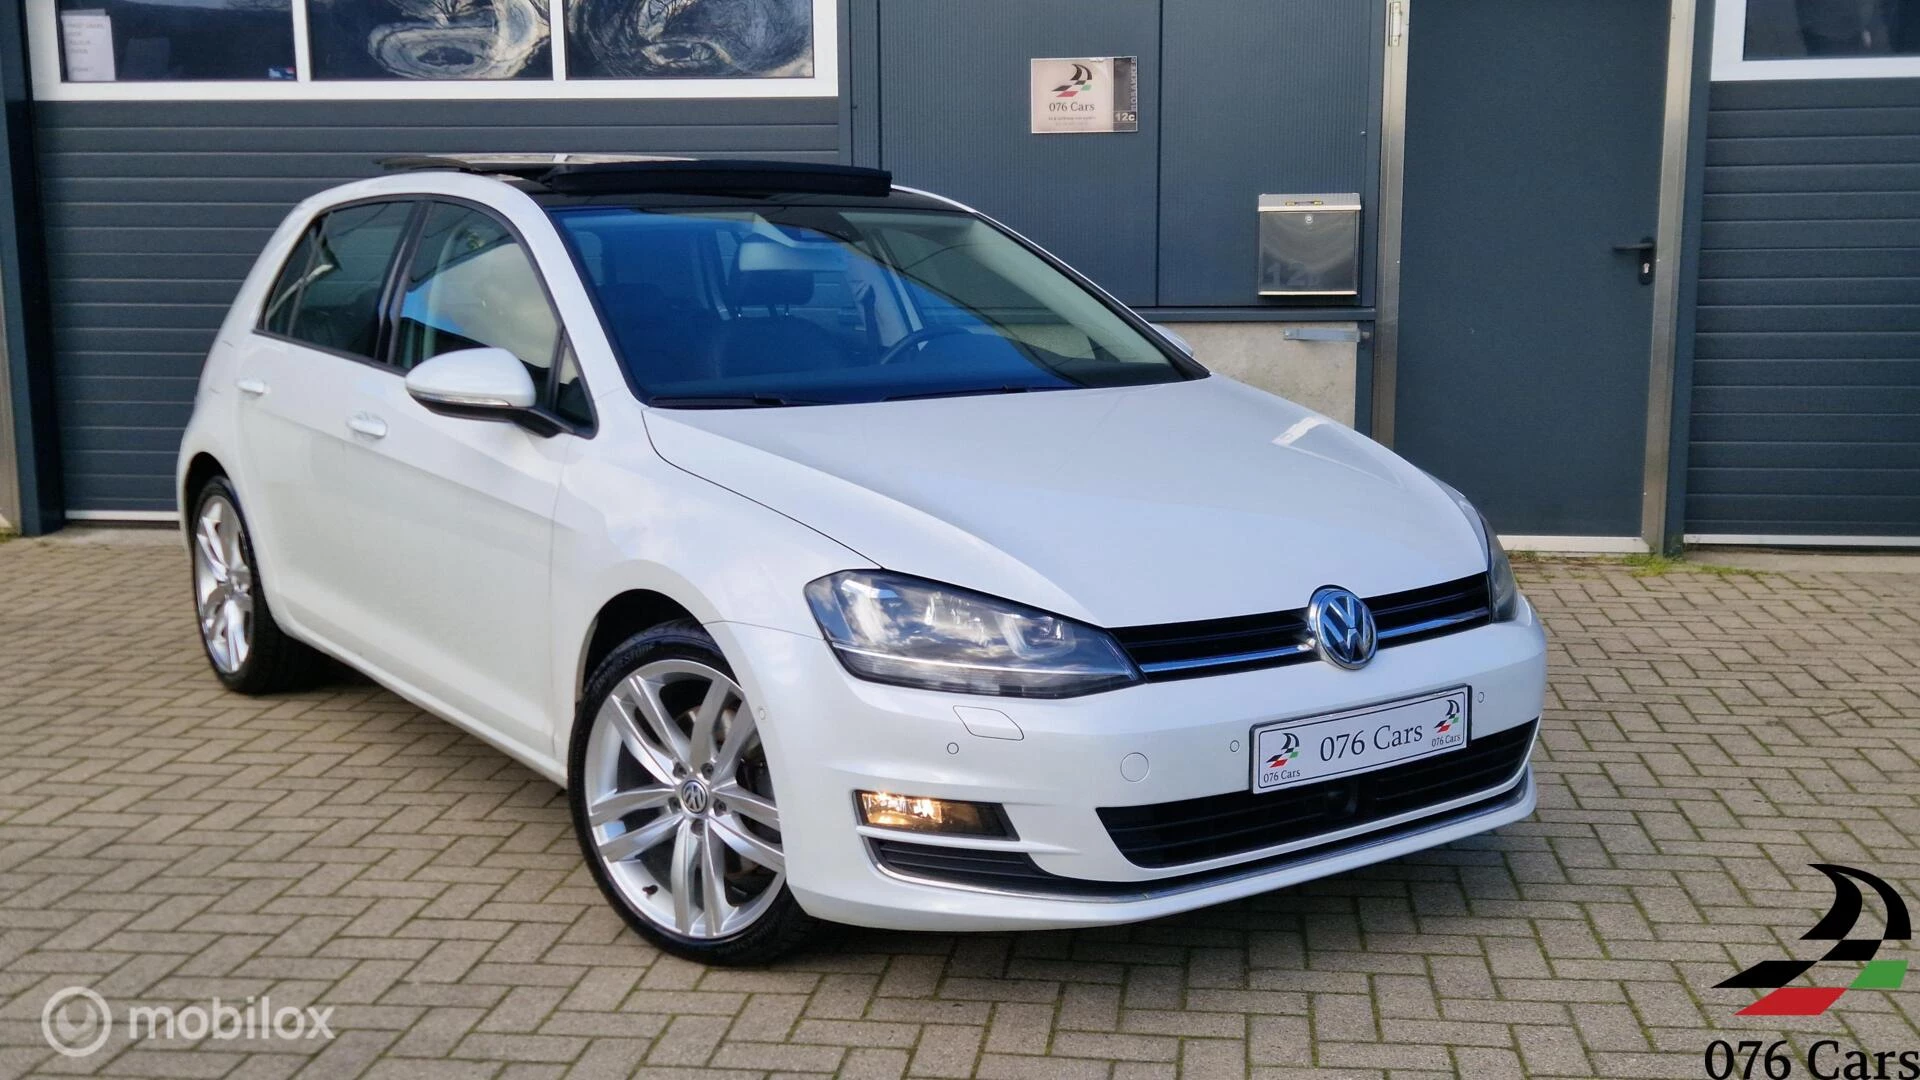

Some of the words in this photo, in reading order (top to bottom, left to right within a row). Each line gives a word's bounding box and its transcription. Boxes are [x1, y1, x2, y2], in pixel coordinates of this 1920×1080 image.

[1049, 102, 1068, 112] 076
[1070, 102, 1095, 111] Cars
[1115, 112, 1135, 122] 12c
[1319, 729, 1366, 762] 076
[1373, 724, 1423, 750] Cars
[1431, 736, 1444, 748] 076
[1444, 733, 1461, 745] Cars
[1263, 770, 1279, 783] 076
[1280, 768, 1301, 780] Cars
